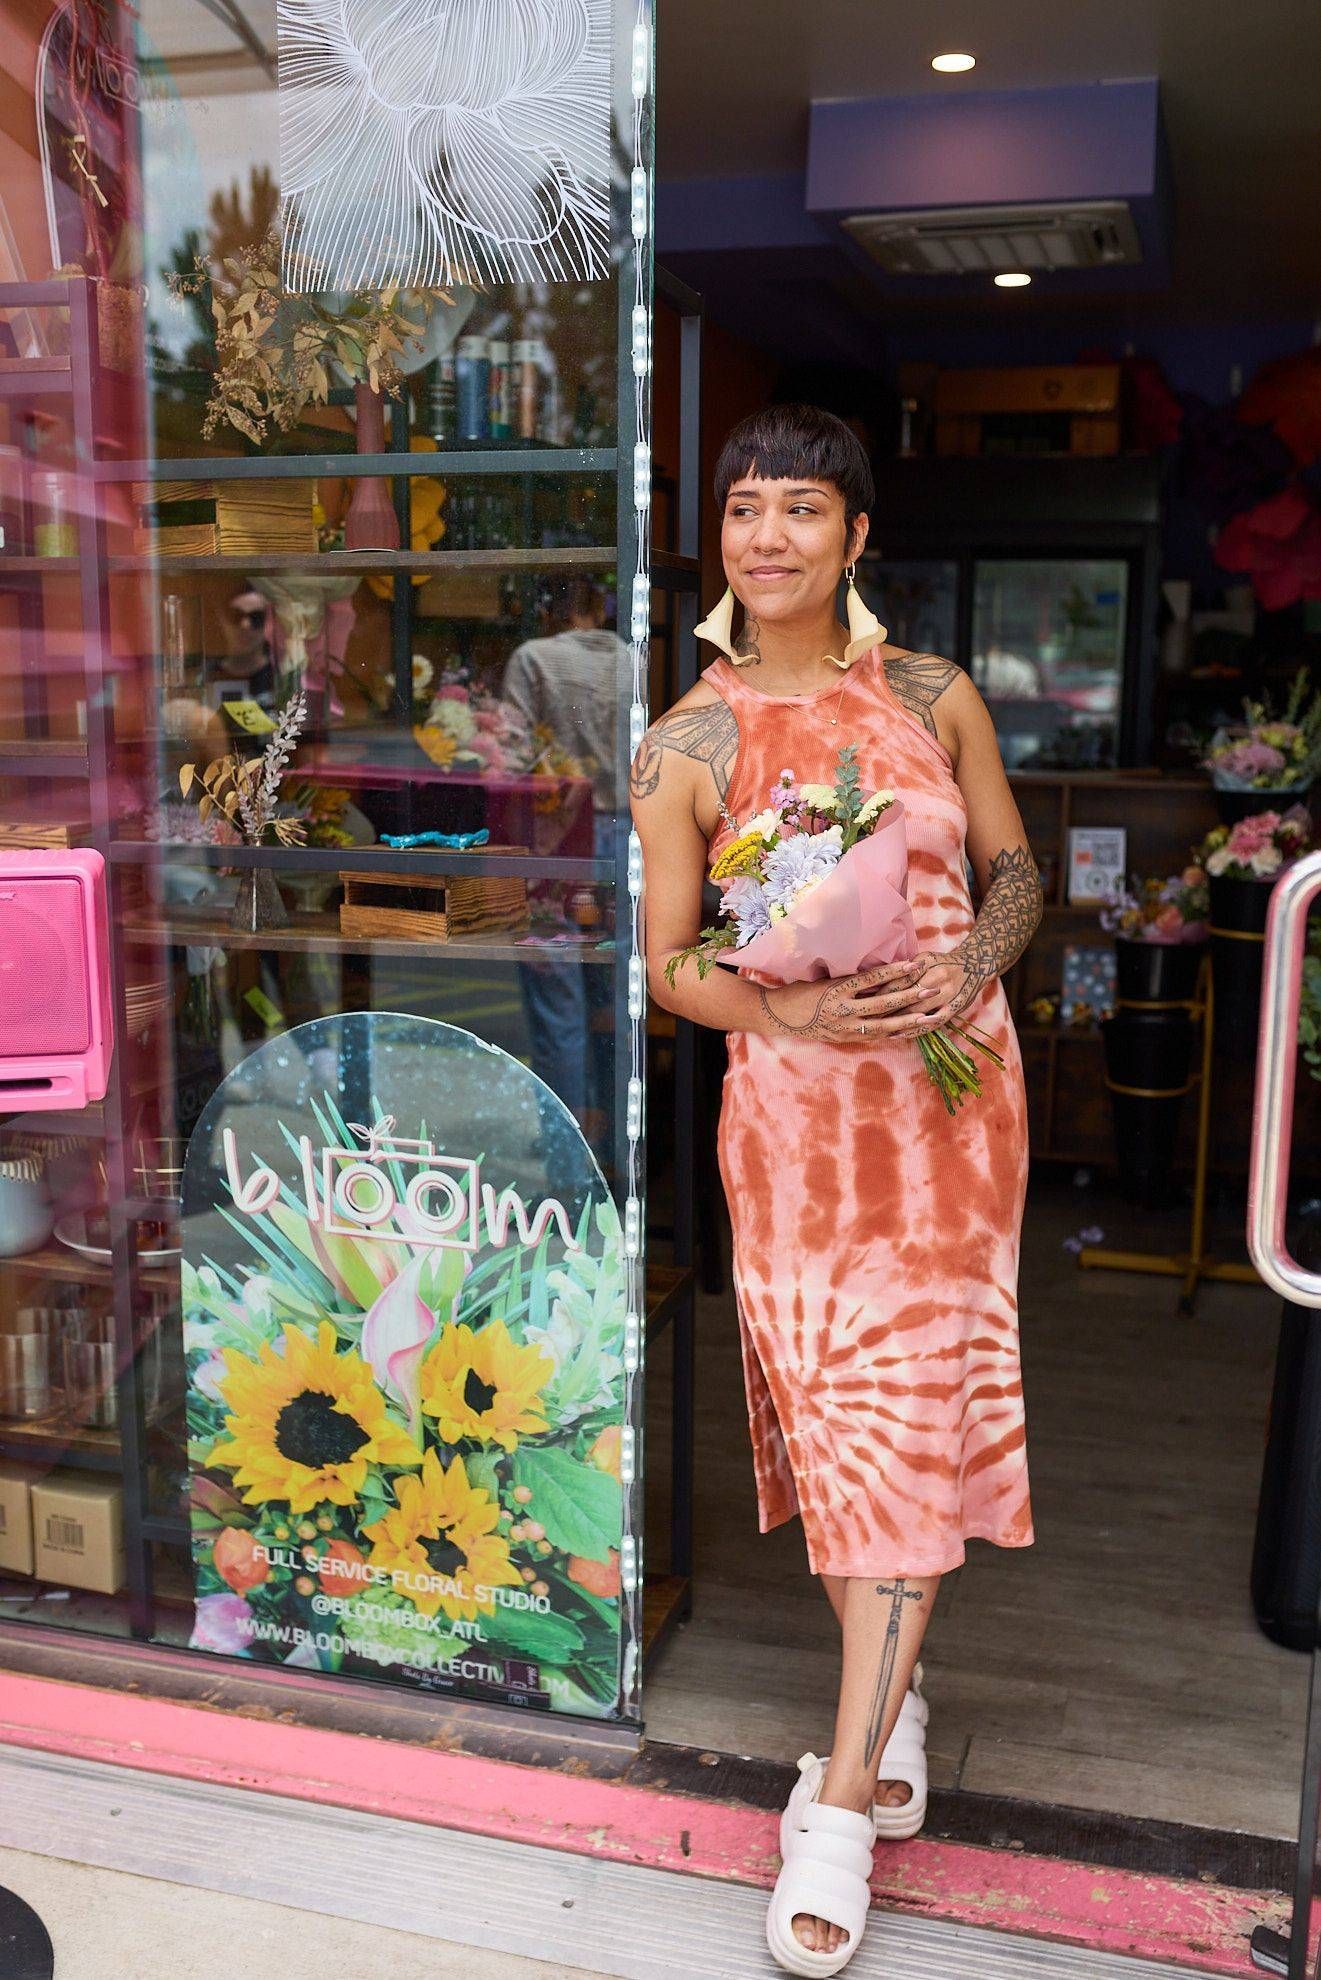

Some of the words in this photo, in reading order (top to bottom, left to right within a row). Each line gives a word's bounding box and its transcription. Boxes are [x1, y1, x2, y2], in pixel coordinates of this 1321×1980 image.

[252, 1545, 302, 1570] FULL
[305, 1552, 388, 1586] SERVICE
[391, 1569, 470, 1600] FLORAL
[474, 1584, 551, 1614] STUDIO
[311, 1594, 488, 1643] @BLOOMBOX_ATL
[235, 1617, 570, 1698] WWW.BLOOMBOXCOLLECTIVOM
